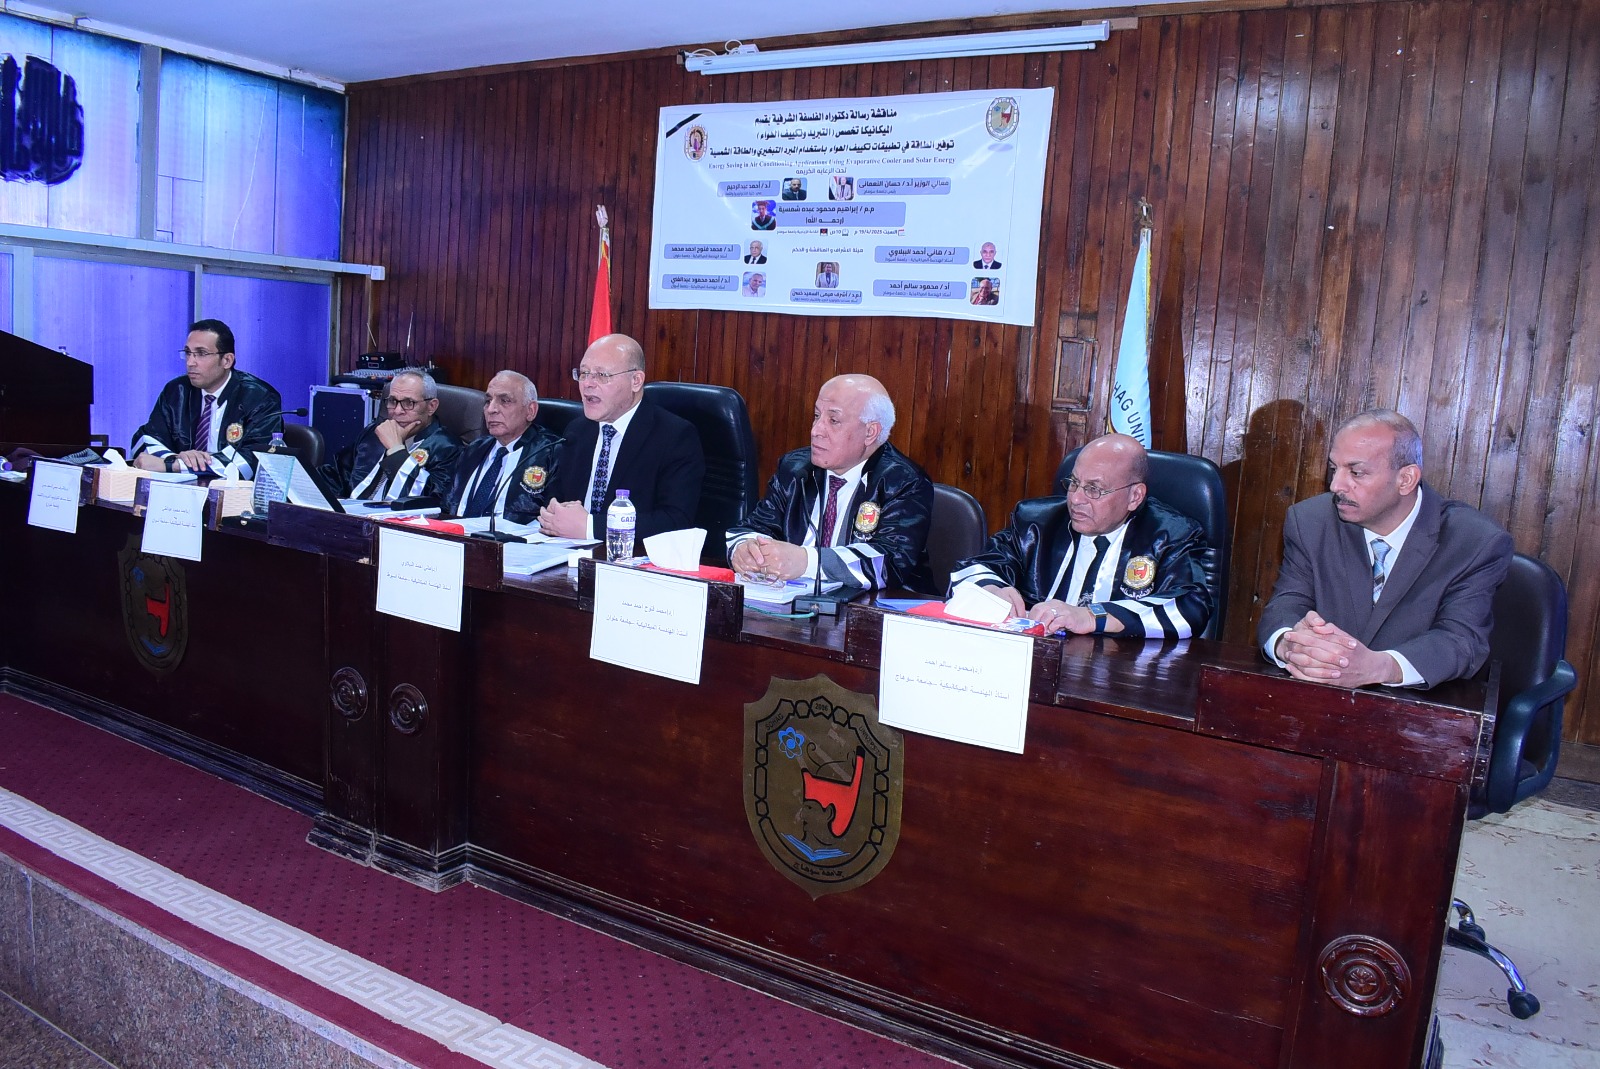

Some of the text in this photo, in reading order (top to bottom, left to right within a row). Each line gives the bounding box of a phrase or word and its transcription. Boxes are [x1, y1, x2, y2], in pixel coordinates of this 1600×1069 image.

[755, 108, 897, 126] مناقشة رسالة دكتوراه الفلسفة الشرفية بقسم
[835, 126, 859, 138] تخصص
[861, 125, 892, 136] الميكانيكا
[829, 144, 848, 154] الهواء
[849, 143, 871, 154] تكييف
[872, 142, 900, 152] تطبيقات
[901, 141, 910, 153] في
[911, 140, 935, 150] الطاقة
[936, 140, 955, 152] توفير
[710, 147, 732, 158] الشمسية
[799, 146, 828, 155] باستخدام
[934, 157, 956, 165] Energy
[748, 181, 760, 189] أحمد
[931, 180, 949, 189] معالي
[816, 206, 836, 214] محمود
[837, 206, 858, 214] إبراهيم
[1114, 381, 1146, 448] HAG UNI
